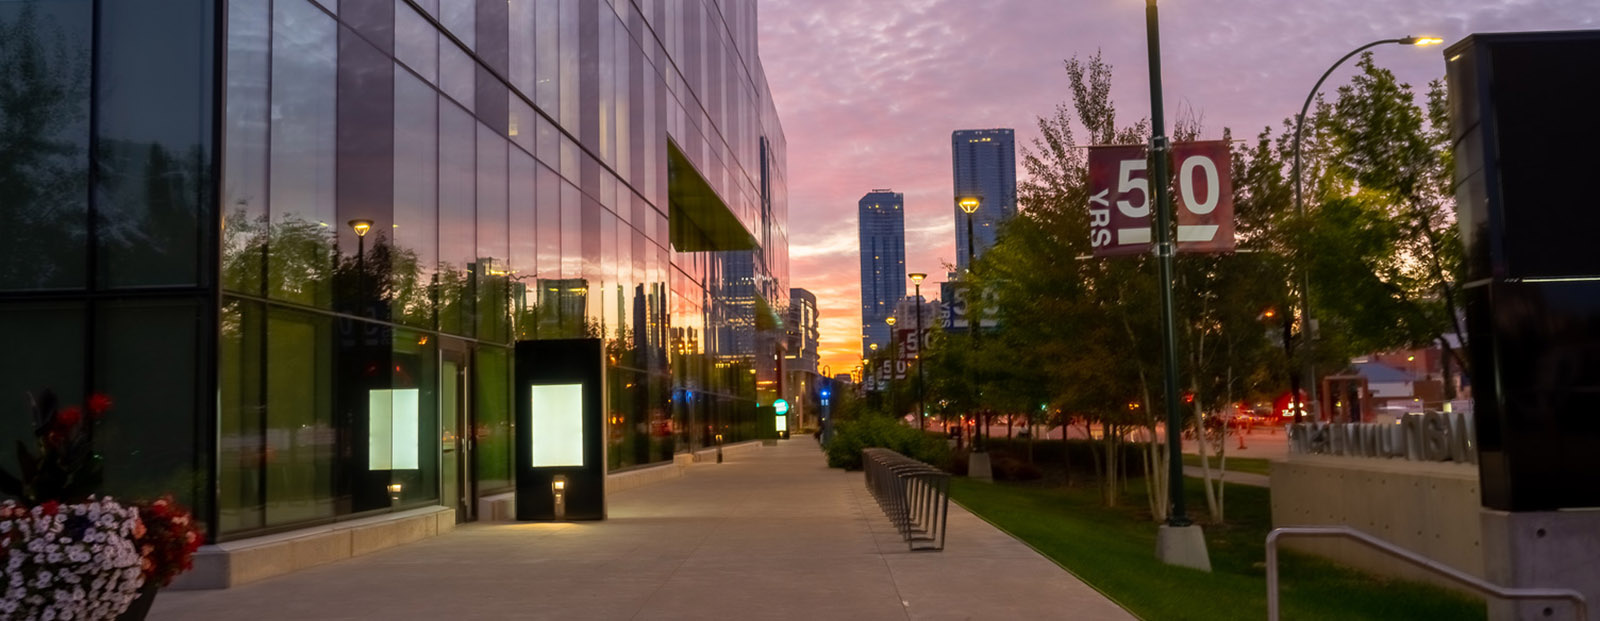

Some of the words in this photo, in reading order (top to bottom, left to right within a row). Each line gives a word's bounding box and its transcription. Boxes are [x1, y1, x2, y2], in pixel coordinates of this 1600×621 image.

[1089, 188, 1112, 247] YRS
[941, 301, 952, 328] YRS
[883, 360, 907, 374] 50
